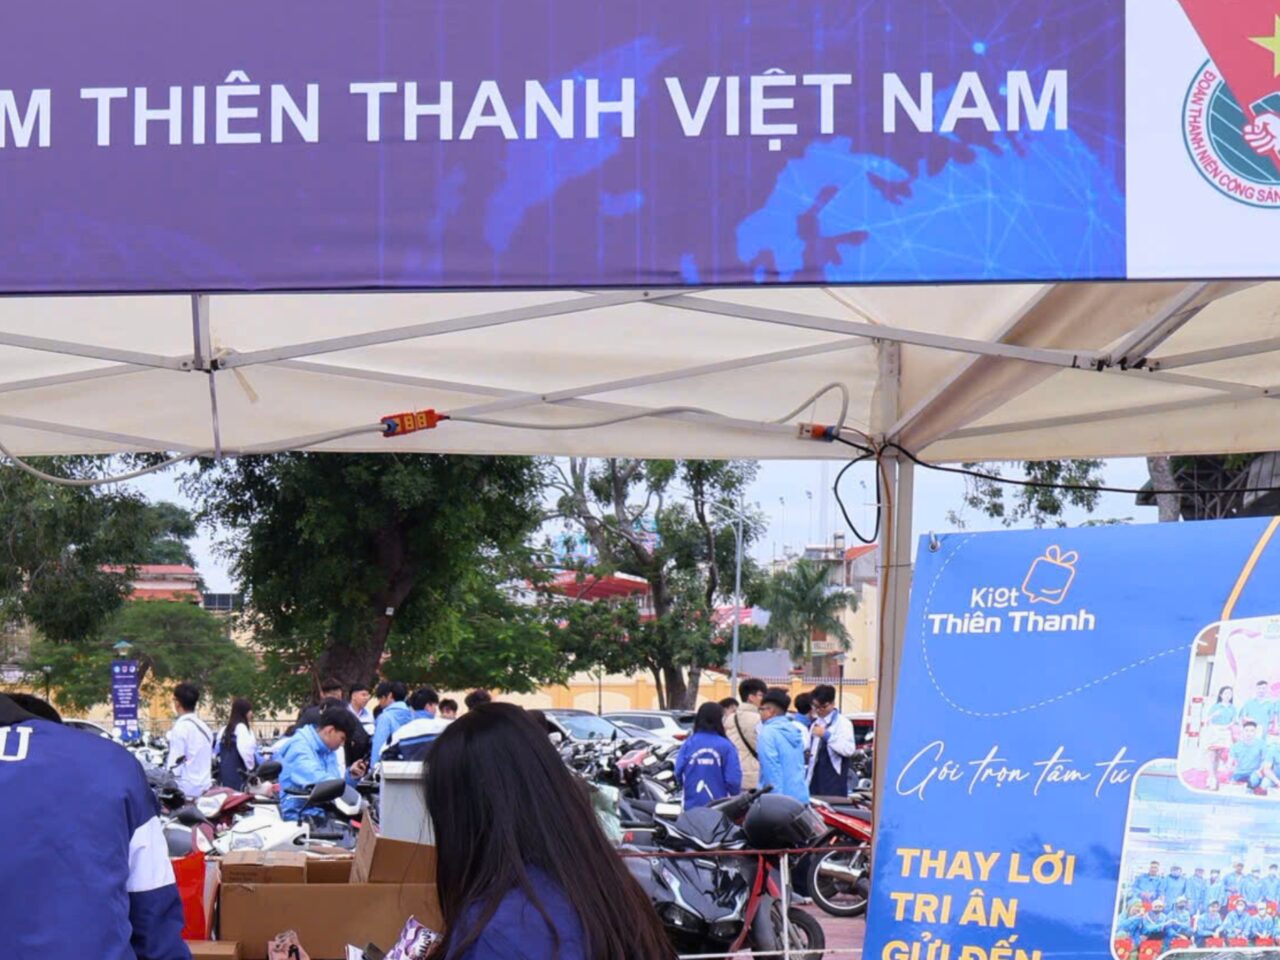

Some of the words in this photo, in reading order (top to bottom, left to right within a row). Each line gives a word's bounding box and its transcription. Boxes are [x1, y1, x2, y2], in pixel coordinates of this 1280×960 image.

[80, 70, 319, 146] THIÊN
[349, 79, 635, 141] THANH
[665, 67, 853, 152] VIỆT
[883, 70, 1068, 133] NAM
[1188, 107, 1206, 151] THANH
[970, 586, 1020, 610] Kiot
[928, 609, 1002, 636] Thiên
[1011, 609, 1097, 634] Thanh
[1033, 746, 1092, 796] tâm
[896, 847, 1003, 884] THAY
[1007, 844, 1076, 885] LỜI
[890, 890, 951, 924] TRI
[959, 889, 1018, 929] ÂN
